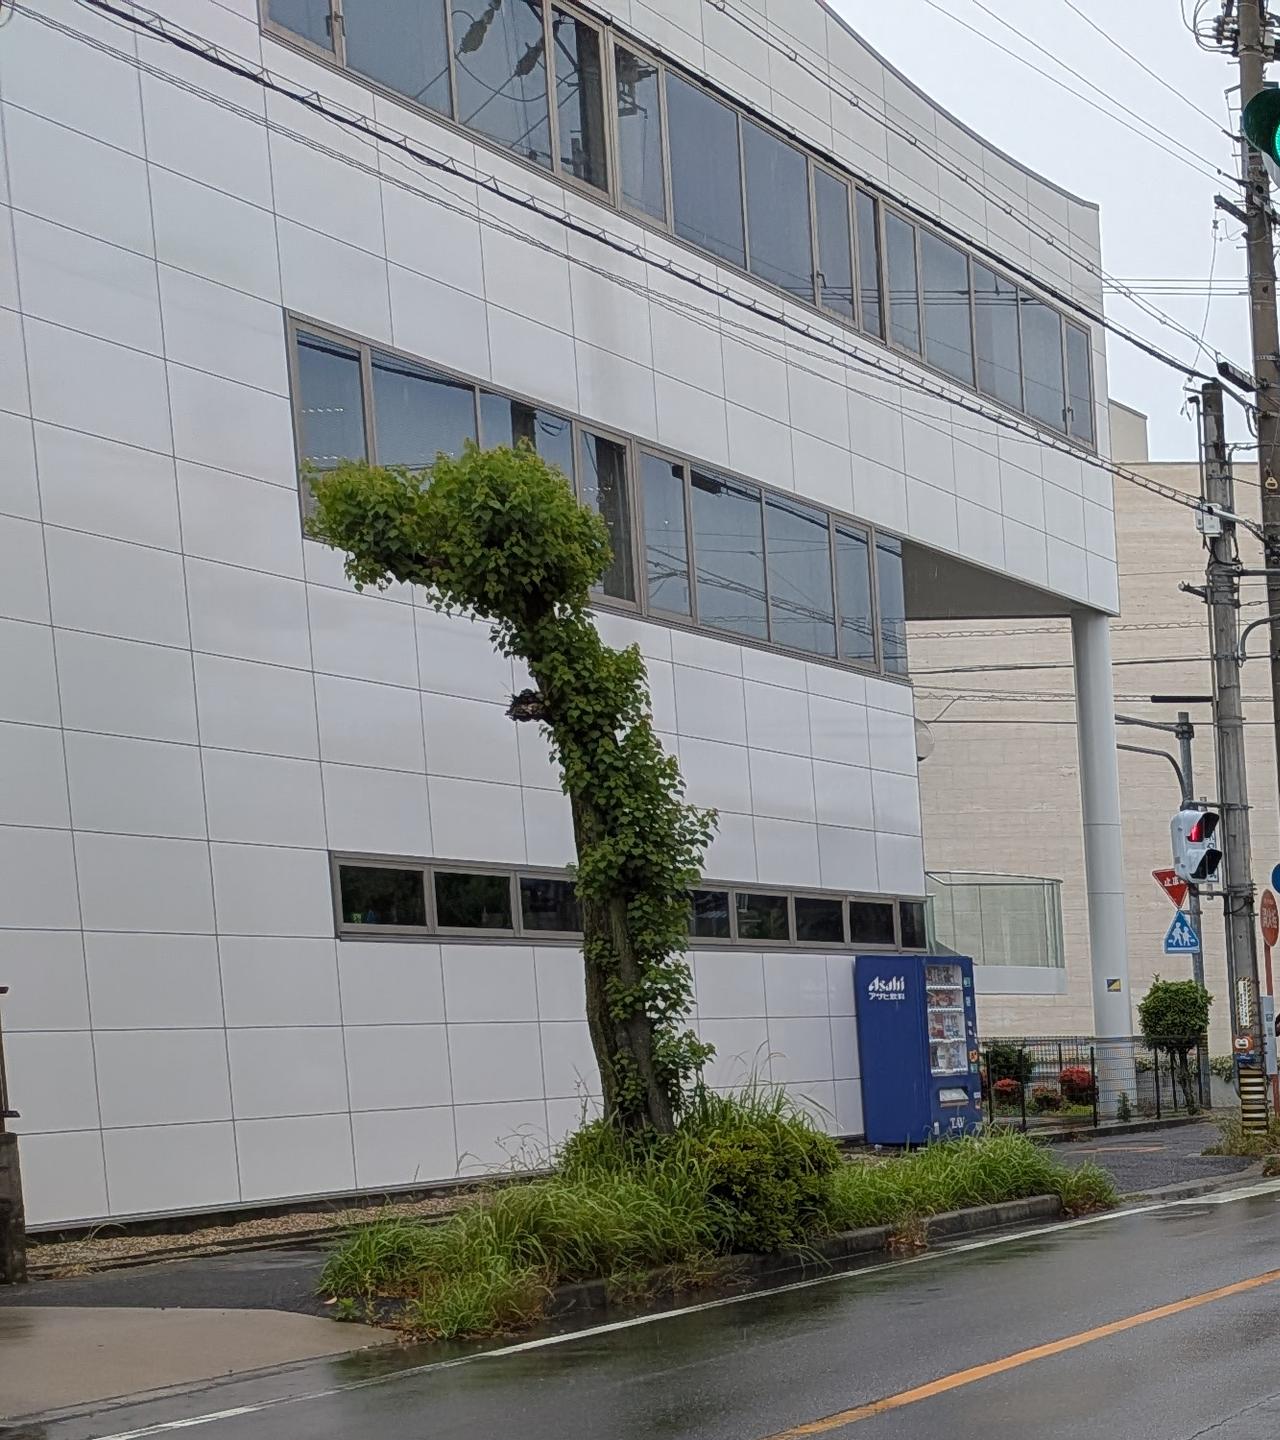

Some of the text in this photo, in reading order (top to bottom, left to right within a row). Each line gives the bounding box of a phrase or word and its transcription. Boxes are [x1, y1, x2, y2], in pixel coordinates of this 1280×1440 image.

[868, 976, 905, 992] Asahi
[868, 992, 905, 1001] アサヒ飲料
